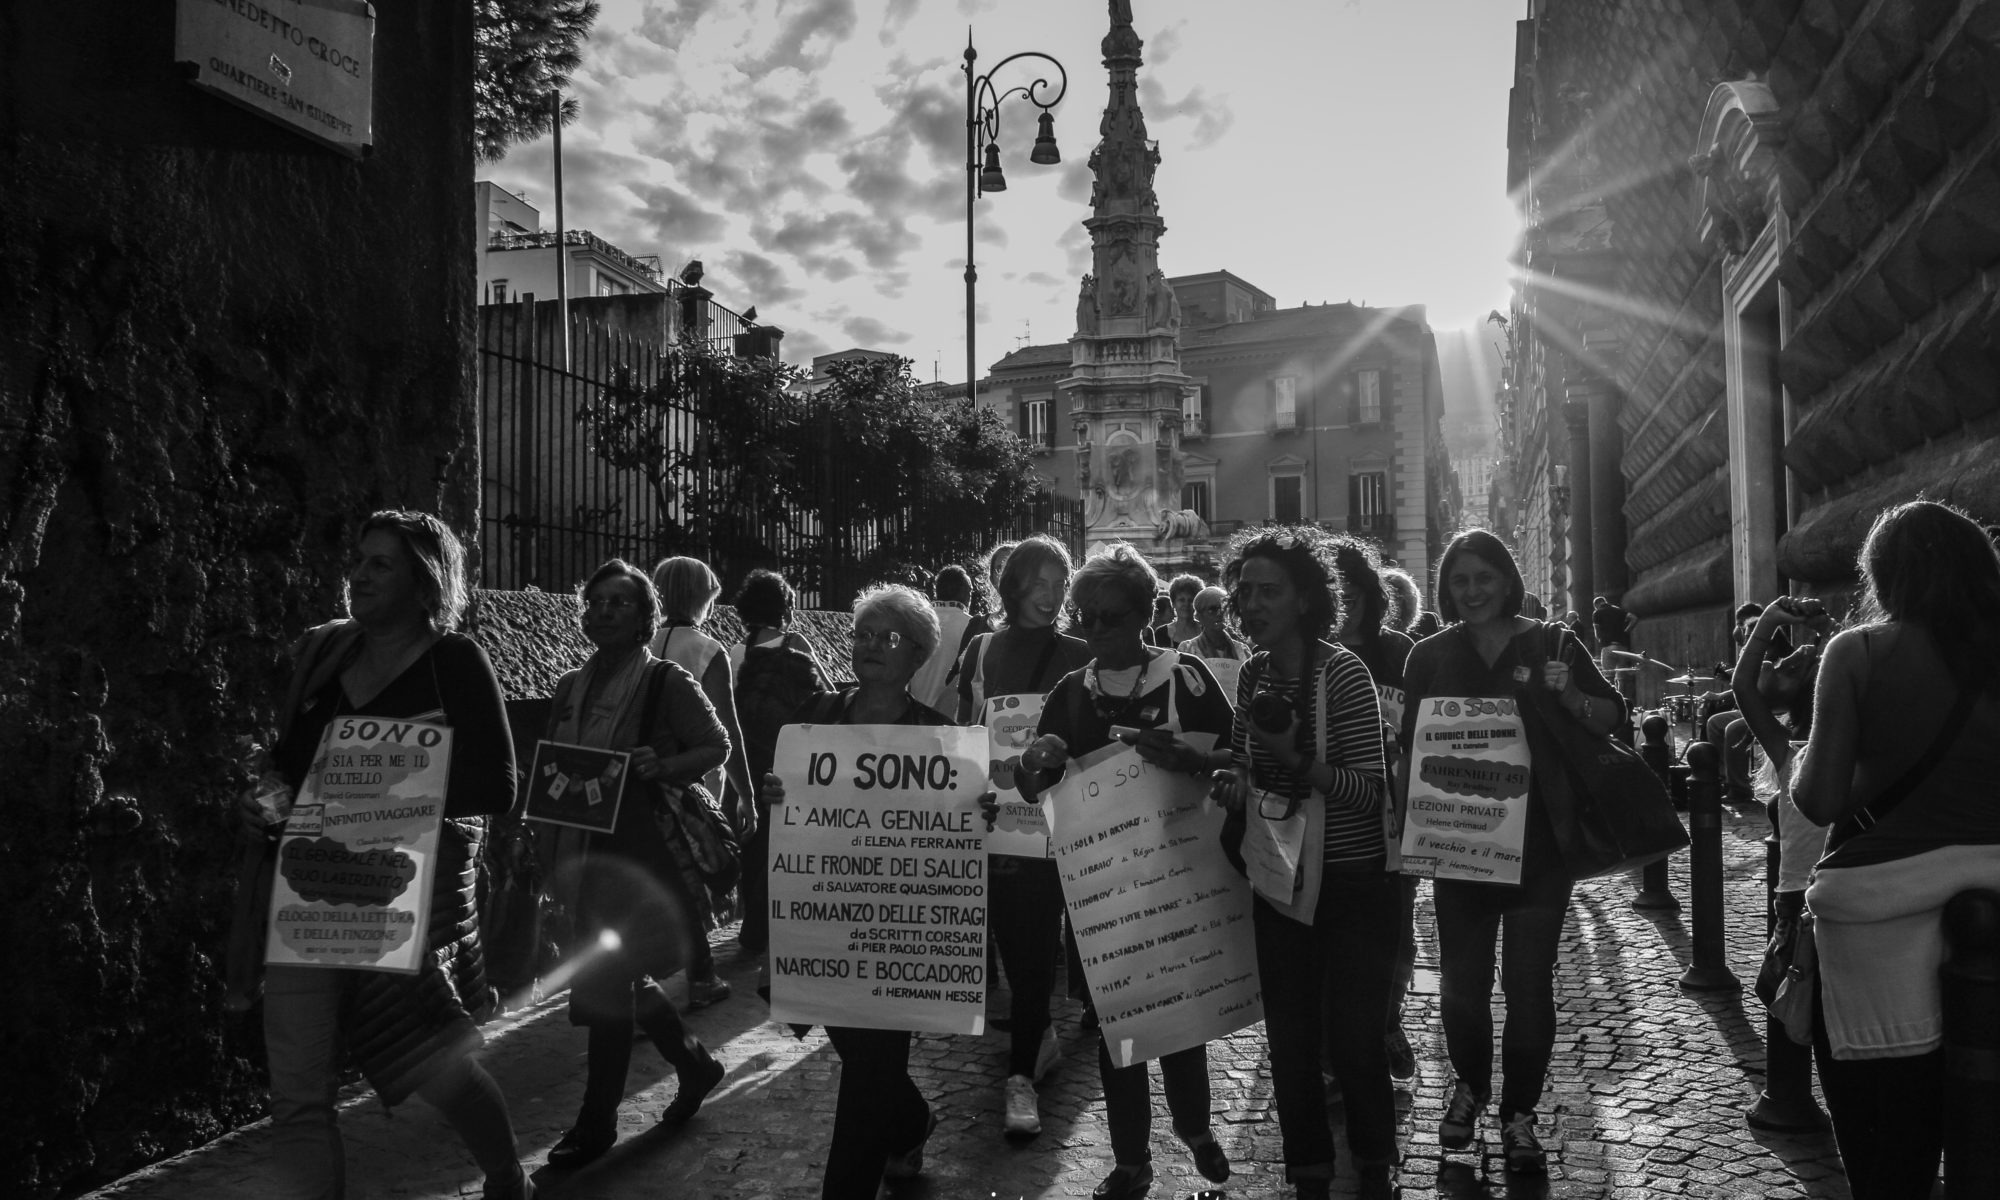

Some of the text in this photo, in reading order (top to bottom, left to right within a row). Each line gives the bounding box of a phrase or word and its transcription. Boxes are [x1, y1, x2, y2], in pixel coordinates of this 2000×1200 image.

[308, 36, 360, 78] CROCE
[209, 57, 353, 136] QUARTIERE SAN GIUSEPPE
[1431, 700, 1461, 717] IO
[339, 719, 442, 747] SONO
[1425, 729, 1516, 741] IL GIUDICE DELLE DONNE
[332, 755, 353, 767] SIA
[360, 754, 382, 767] PER
[389, 755, 405, 767] ME
[414, 755, 426, 767] IL
[324, 772, 382, 785] COLTELLO
[808, 752, 957, 791] IO SONO:
[1424, 764, 1524, 785] FAHRENHEIT 451
[1081, 781, 1100, 802] IO
[374, 804, 436, 822] VIAGGIARE
[1412, 800, 1505, 817] LEZIONI PRIVATE
[881, 810, 973, 832] GENIALE
[1425, 817, 1487, 831] Helene Grimaud
[851, 835, 983, 850] di ELENA FERRANTE
[1098, 831, 1108, 842] DI
[1417, 836, 1426, 846] Il
[1429, 840, 1466, 854] vecchio
[1482, 847, 1491, 858] il
[1493, 851, 1522, 862] mare
[304, 848, 375, 866] GENERALE
[379, 854, 409, 868] NEL
[772, 853, 983, 879] ALLE FRONDE DEI SALICI
[1448, 860, 1495, 876] Hemingway
[290, 869, 403, 889] SUO LABIRINTO
[812, 881, 984, 897] di SALVATORE QUASIMODO
[1117, 886, 1127, 896] di
[277, 911, 415, 923] ELOGIO DELLA LETTURA
[771, 900, 986, 927] IL ROMANZO DELLE STRAGI
[1119, 909, 1142, 925] TUTTE
[1144, 907, 1159, 918] DAL
[293, 928, 397, 940] E DELLA FINZIONE
[850, 928, 983, 944] da SCRITTI CORSARI
[847, 941, 983, 958] di PIER PAOLO PASOLINI
[1101, 942, 1145, 963] BASTARDA
[1145, 939, 1155, 950] DI
[775, 957, 983, 985] NARCISO E BOCCADORO
[1145, 970, 1155, 980] di
[872, 987, 983, 1004] di HERMANN HESSE
[1120, 1005, 1145, 1020] CASA
